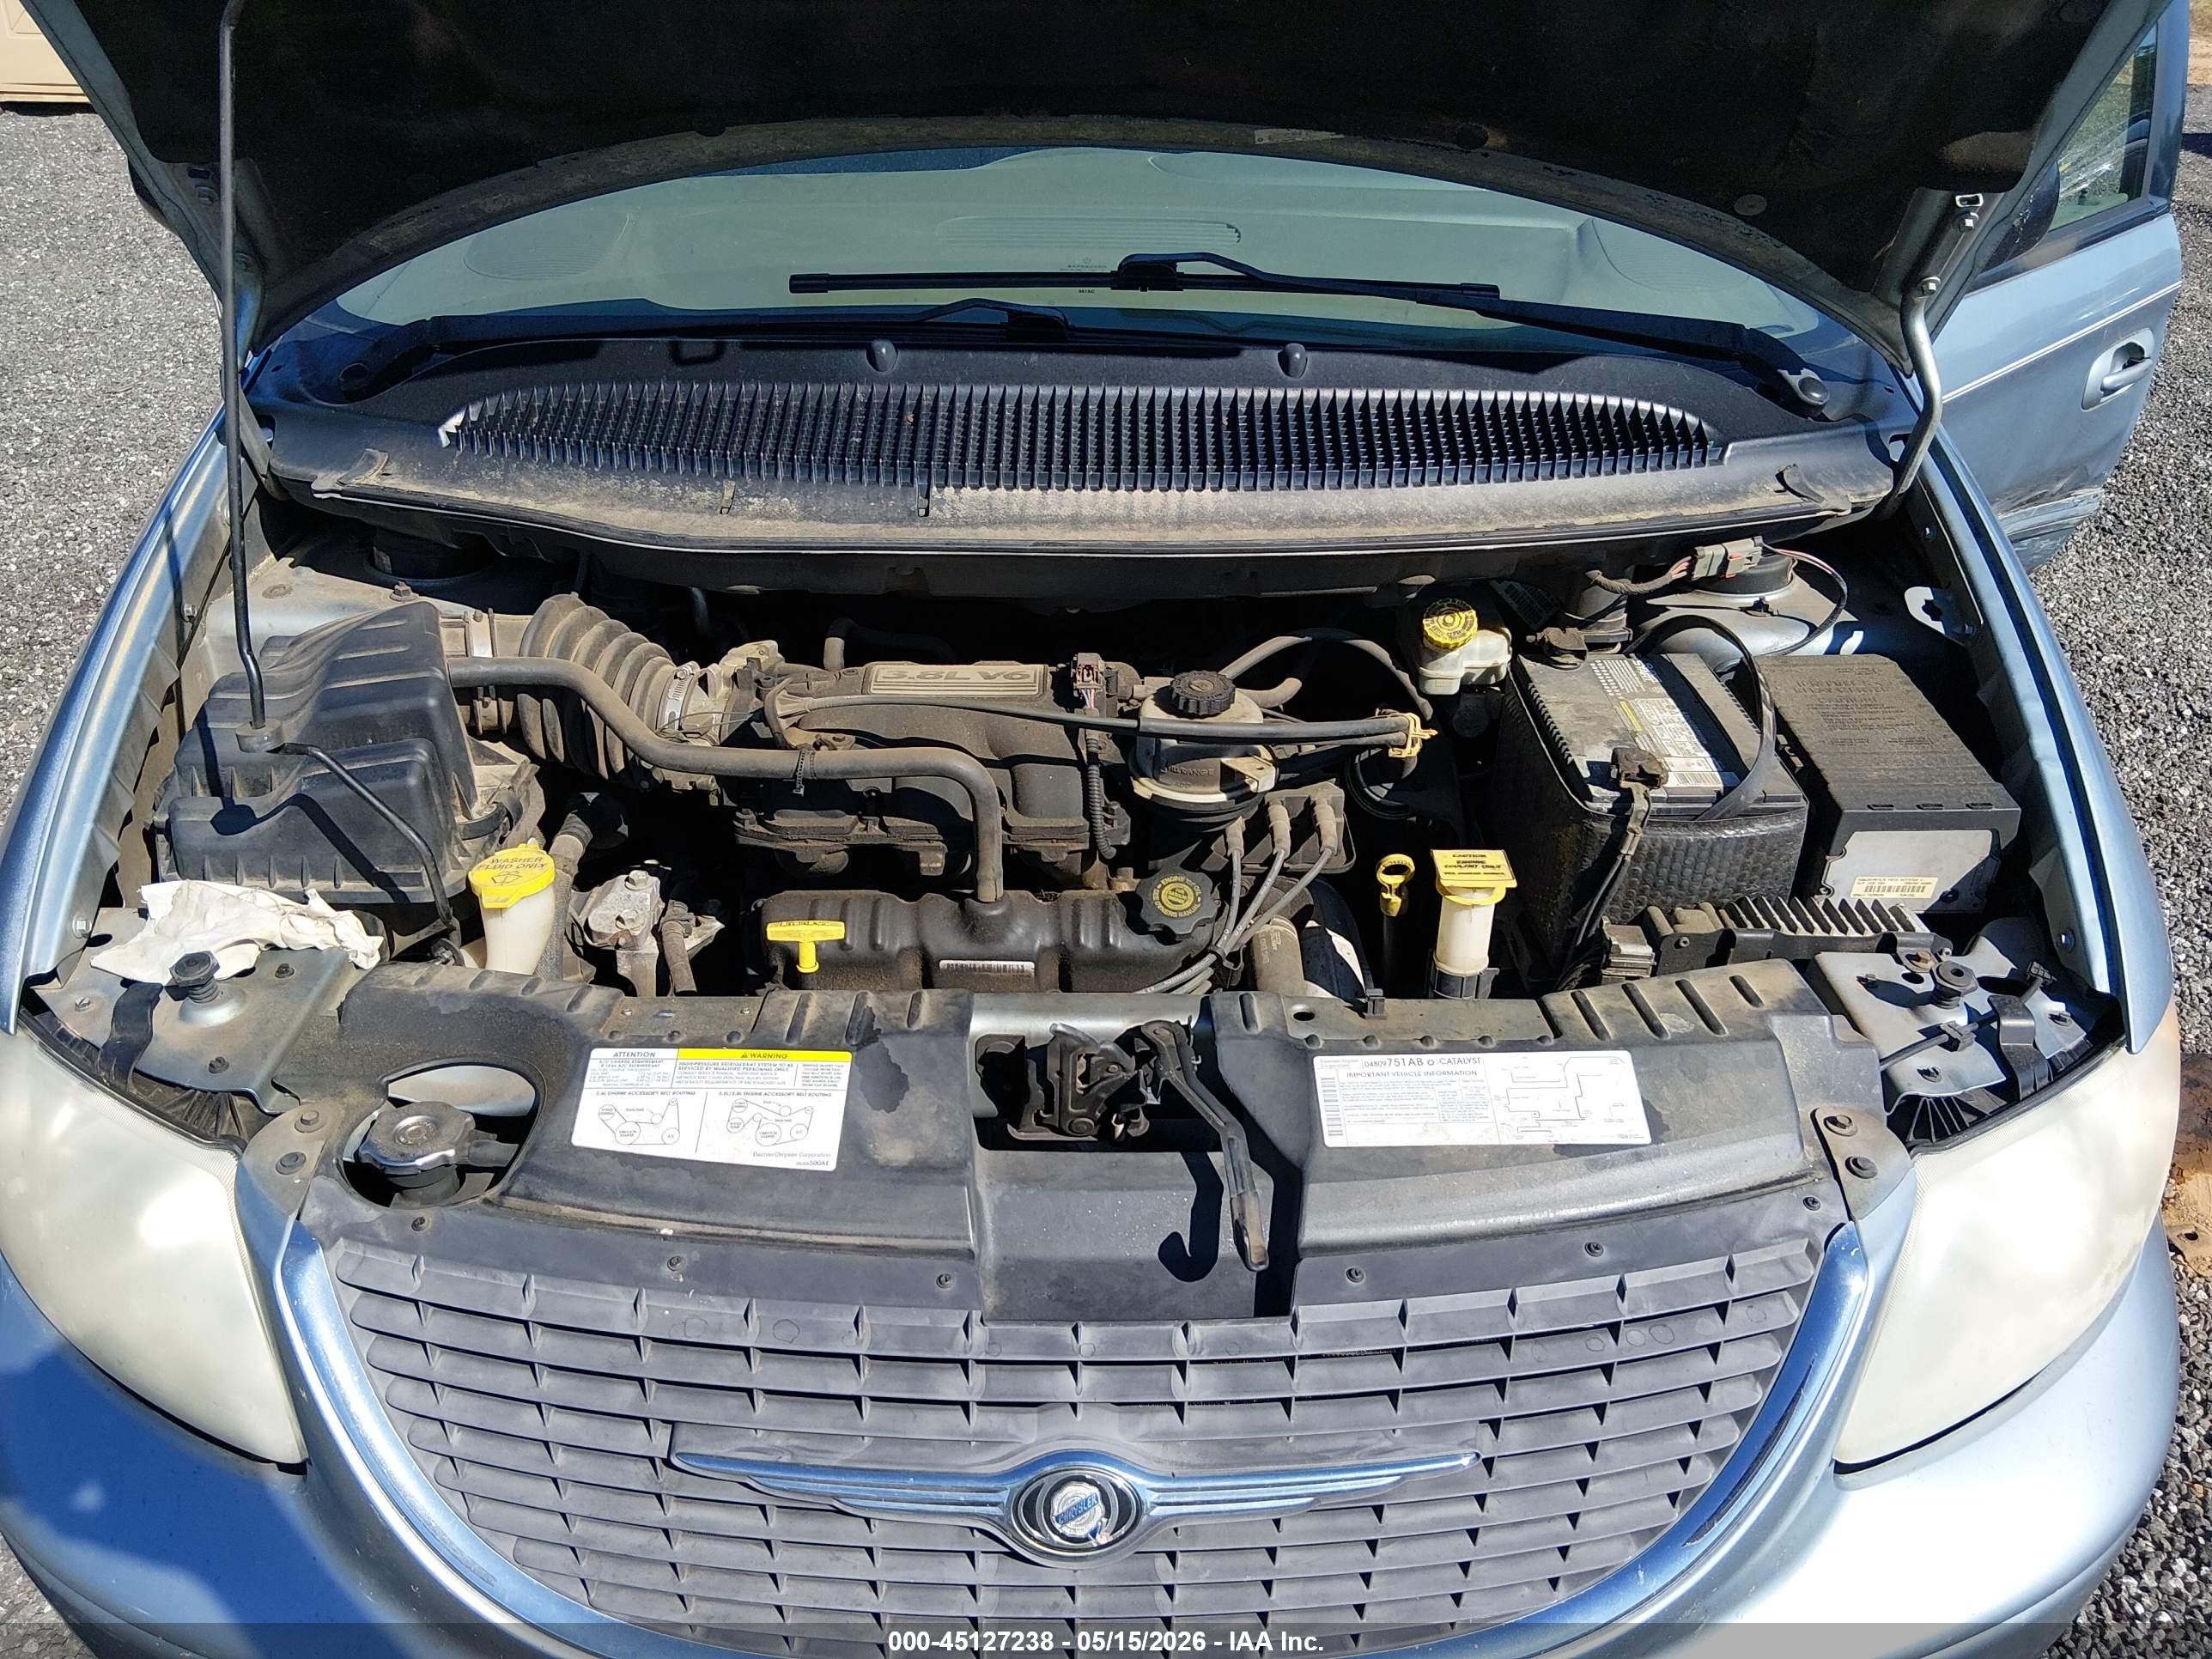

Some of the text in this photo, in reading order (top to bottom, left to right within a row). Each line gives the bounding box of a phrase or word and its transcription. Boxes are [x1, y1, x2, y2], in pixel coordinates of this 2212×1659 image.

[882, 670, 1030, 681] 3.8L V6
[1182, 768, 1215, 776] RANGE
[1057, 1493, 1098, 1525] CHRYSLER
